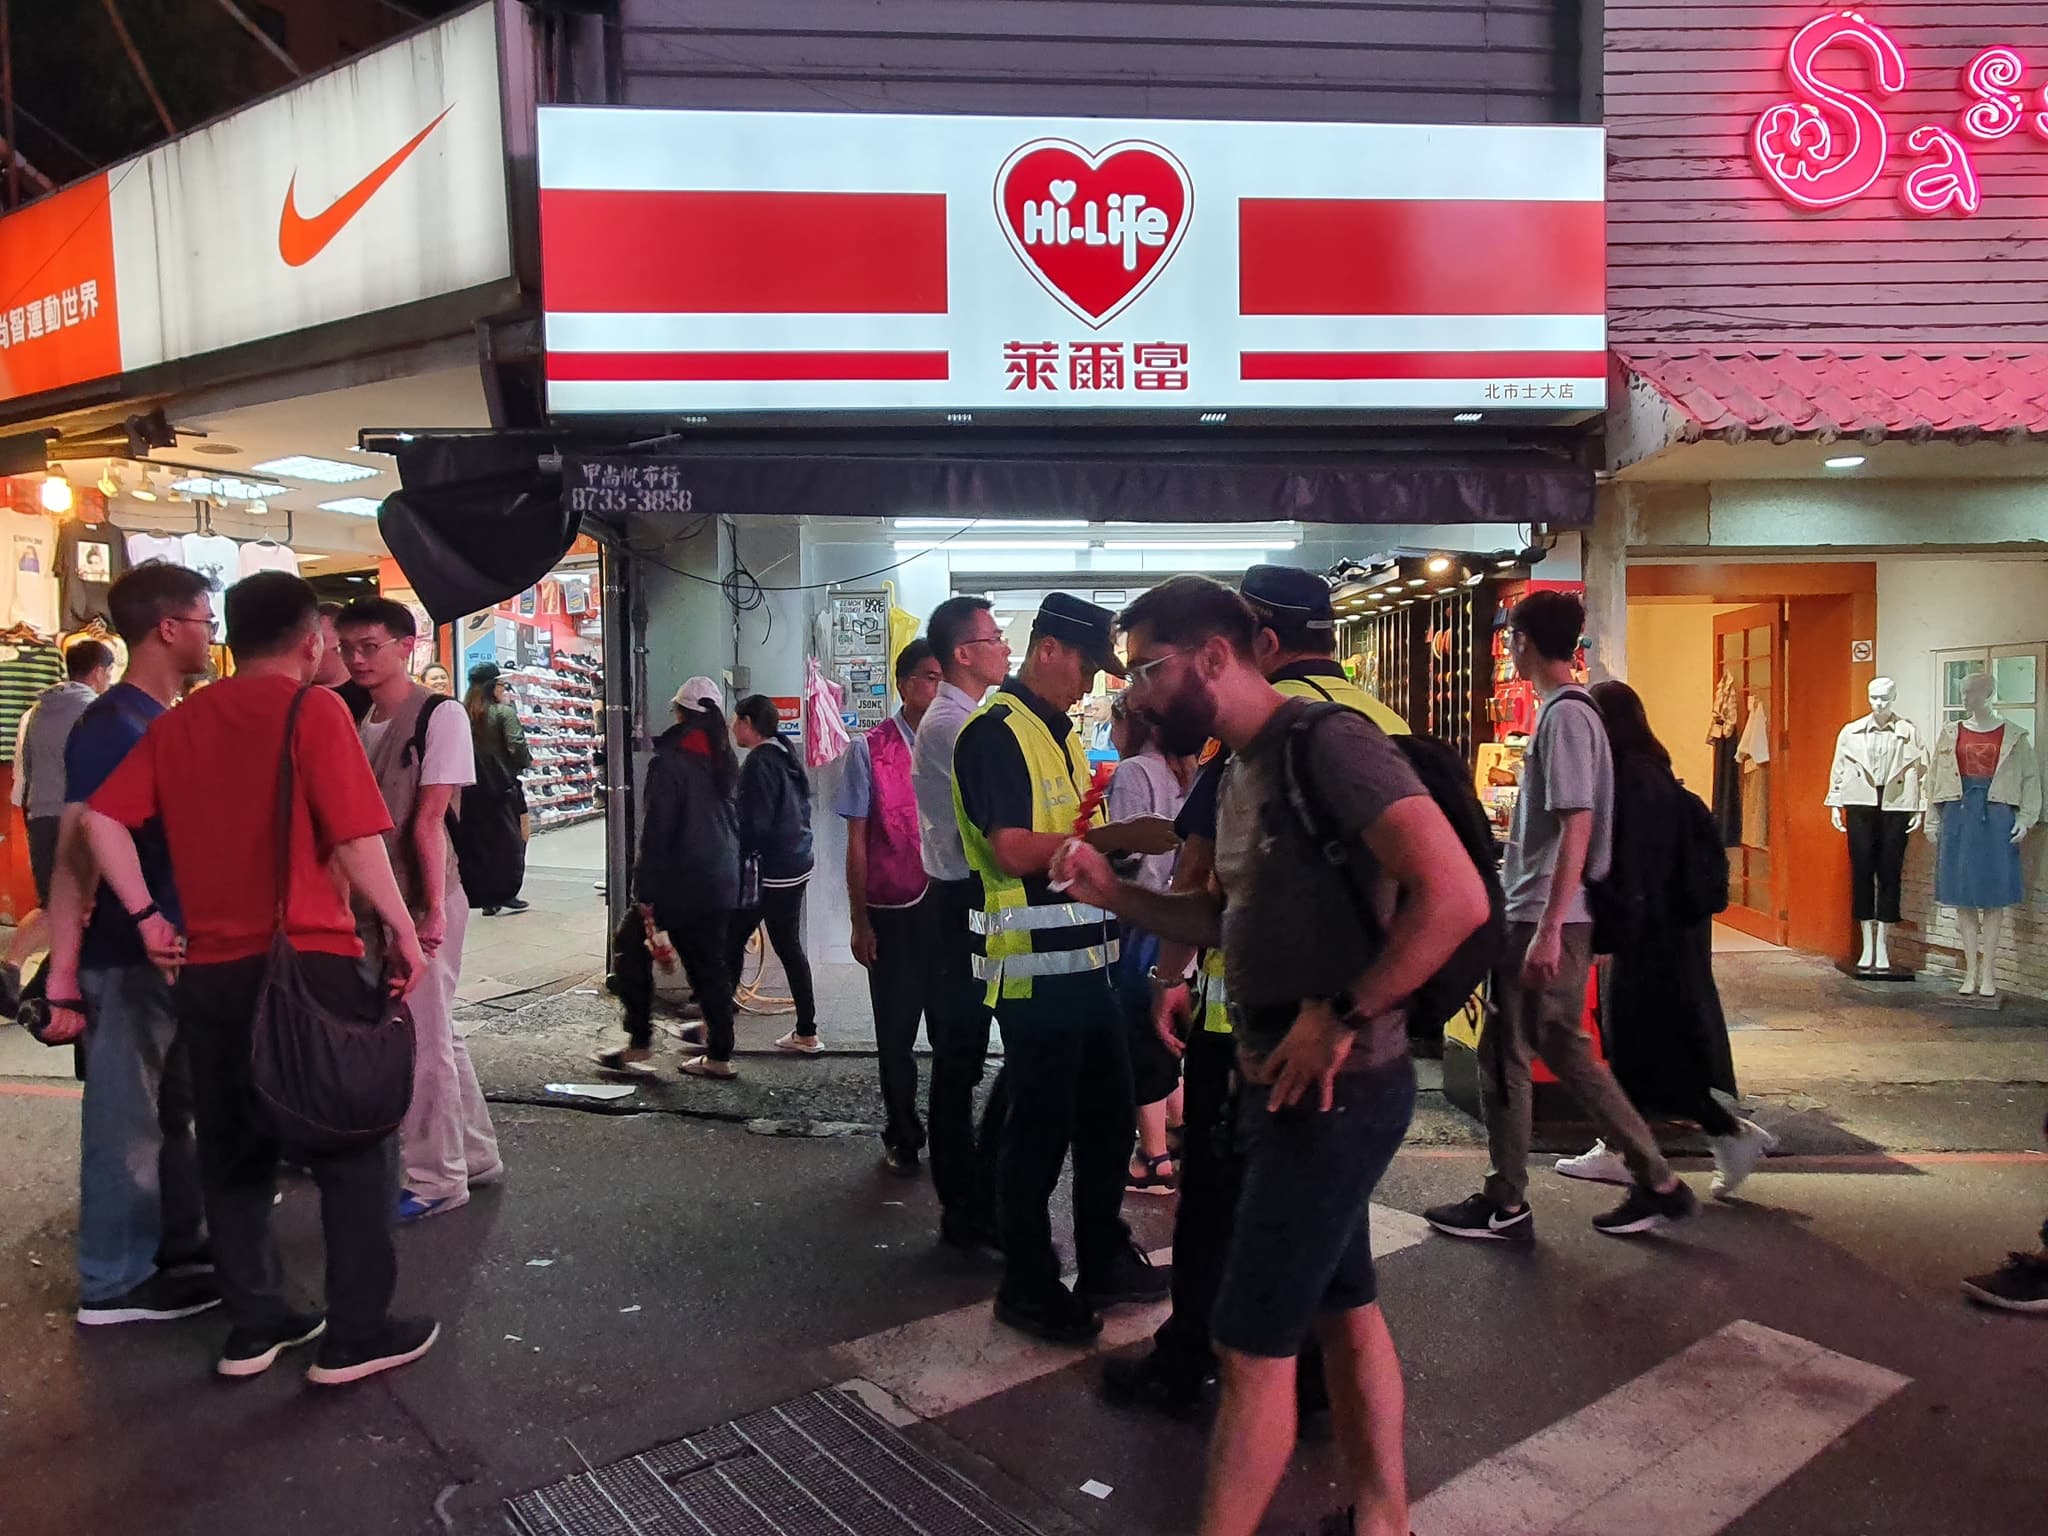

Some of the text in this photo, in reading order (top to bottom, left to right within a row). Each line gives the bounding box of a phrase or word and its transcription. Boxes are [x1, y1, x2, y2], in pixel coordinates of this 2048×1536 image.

[1023, 179, 1169, 271] Hi-Life
[1003, 341, 1188, 391] 萊爾富
[1484, 383, 1574, 400] 北市士大店
[572, 487, 693, 511] 8733-3858
